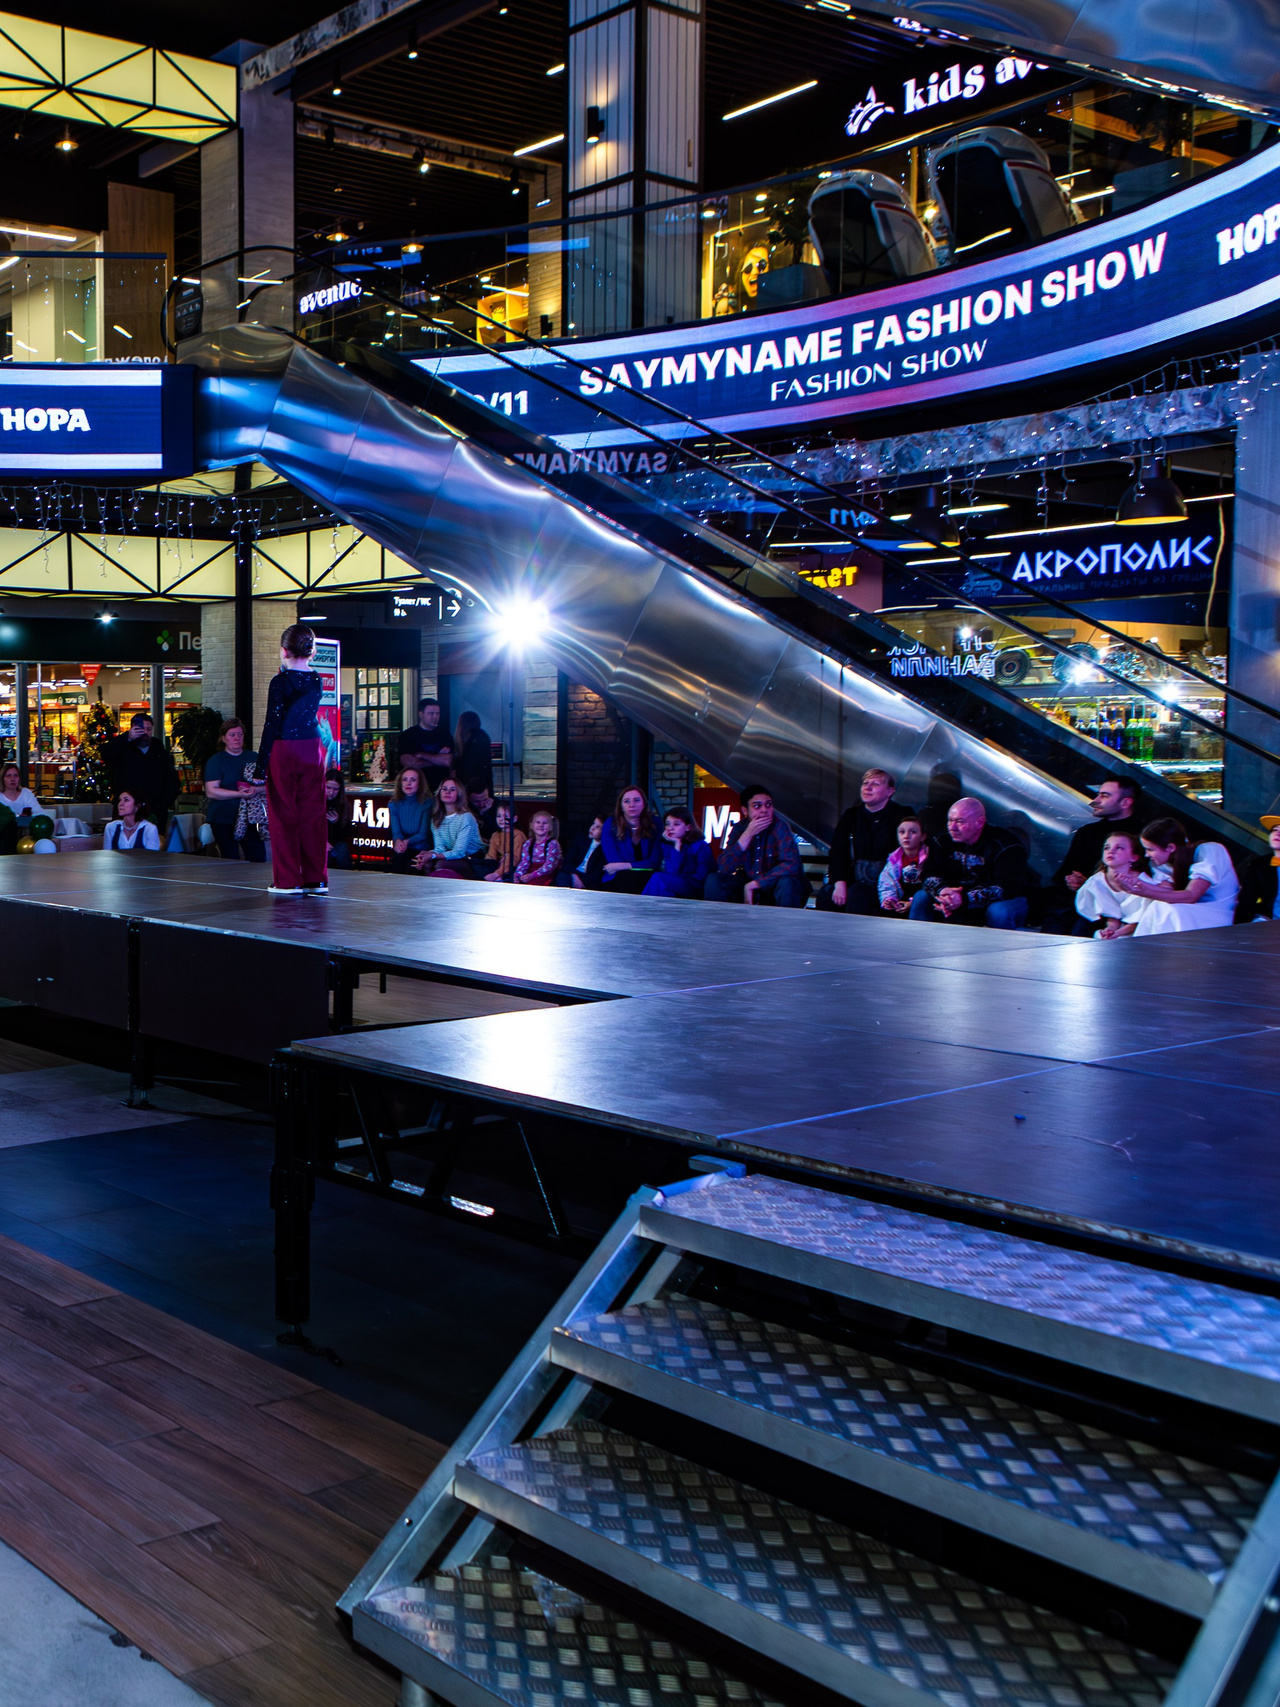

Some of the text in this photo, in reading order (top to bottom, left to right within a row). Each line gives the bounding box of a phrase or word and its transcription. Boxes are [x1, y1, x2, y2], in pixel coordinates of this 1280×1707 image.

[902, 64, 985, 115] kids
[299, 279, 362, 314] avenue
[579, 232, 1167, 395] SAYMYNAME FASHION SHOW
[771, 339, 987, 401] FASHION SHOW
[1011, 536, 1213, 583] АКРОПОЛИС
[351, 799, 390, 830] Мя
